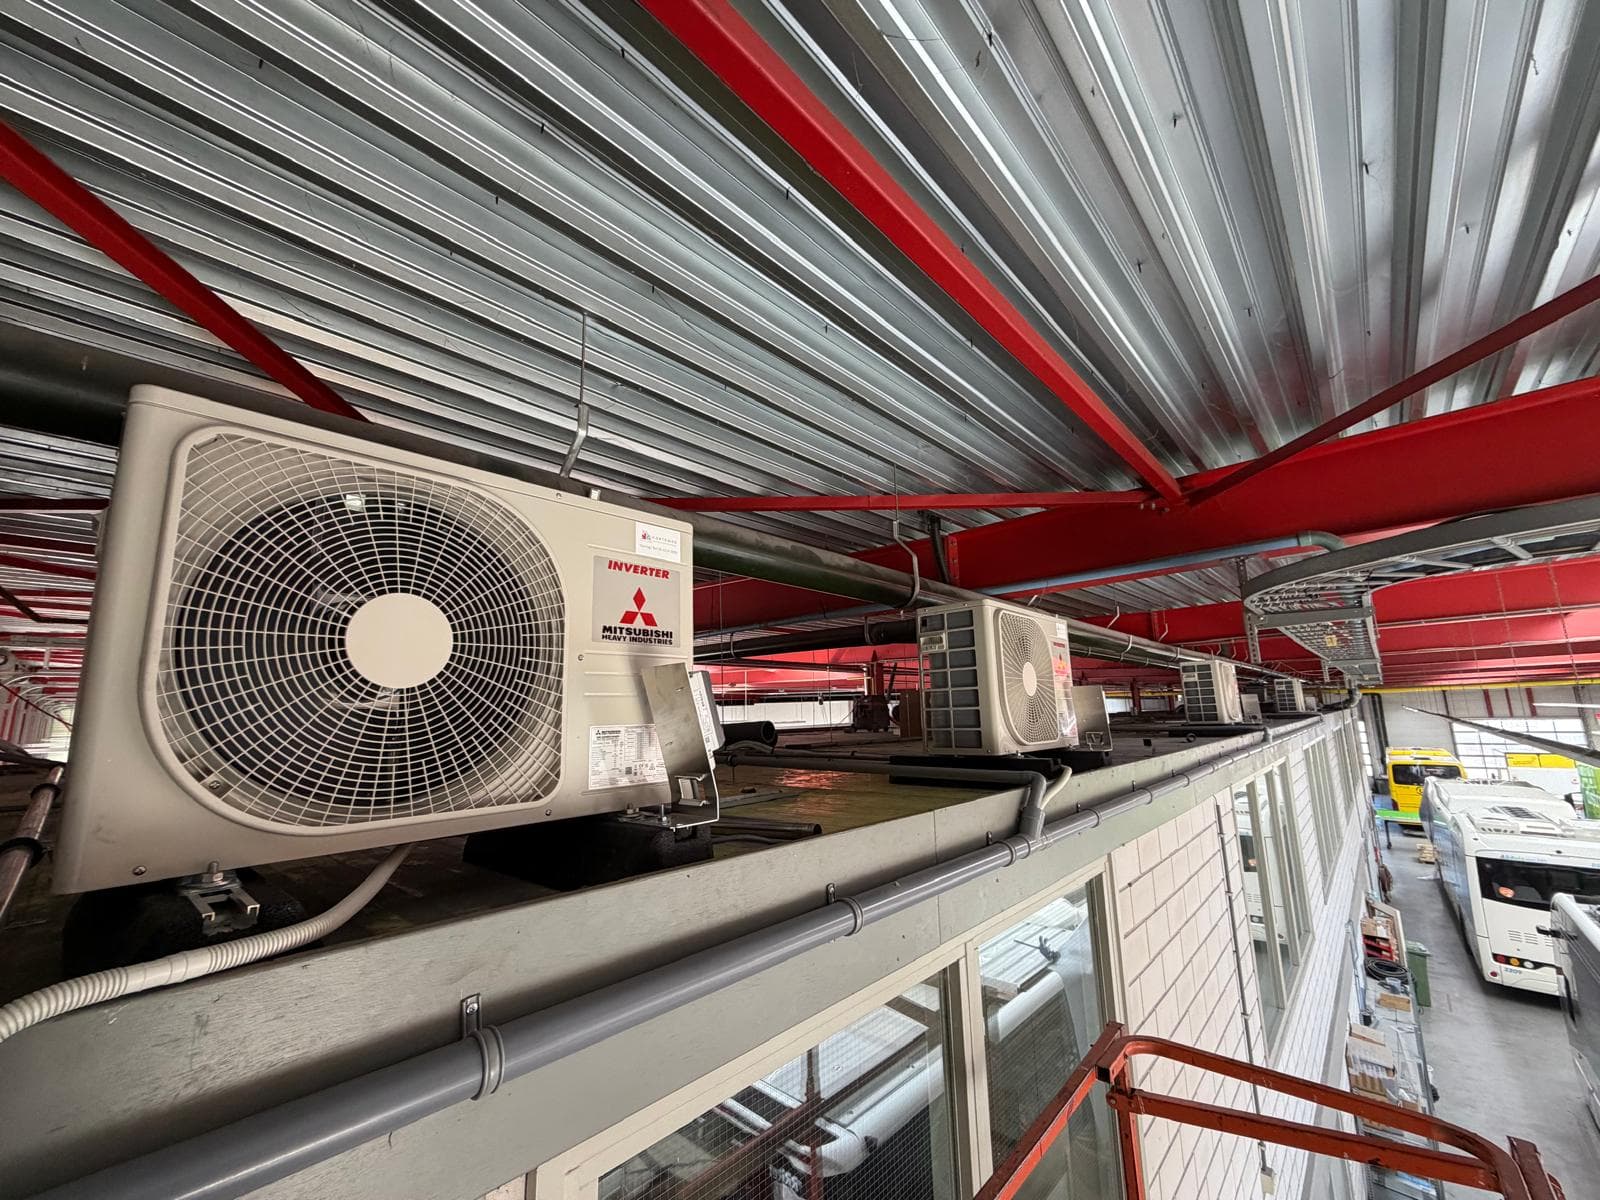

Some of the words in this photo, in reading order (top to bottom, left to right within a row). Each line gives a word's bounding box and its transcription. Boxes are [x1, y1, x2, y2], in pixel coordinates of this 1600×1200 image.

[607, 559, 670, 579] INVERTER
[602, 625, 673, 638] MITSUBISHI
[602, 634, 627, 642] HEAVY
[629, 636, 673, 646] INDUSTRIES
